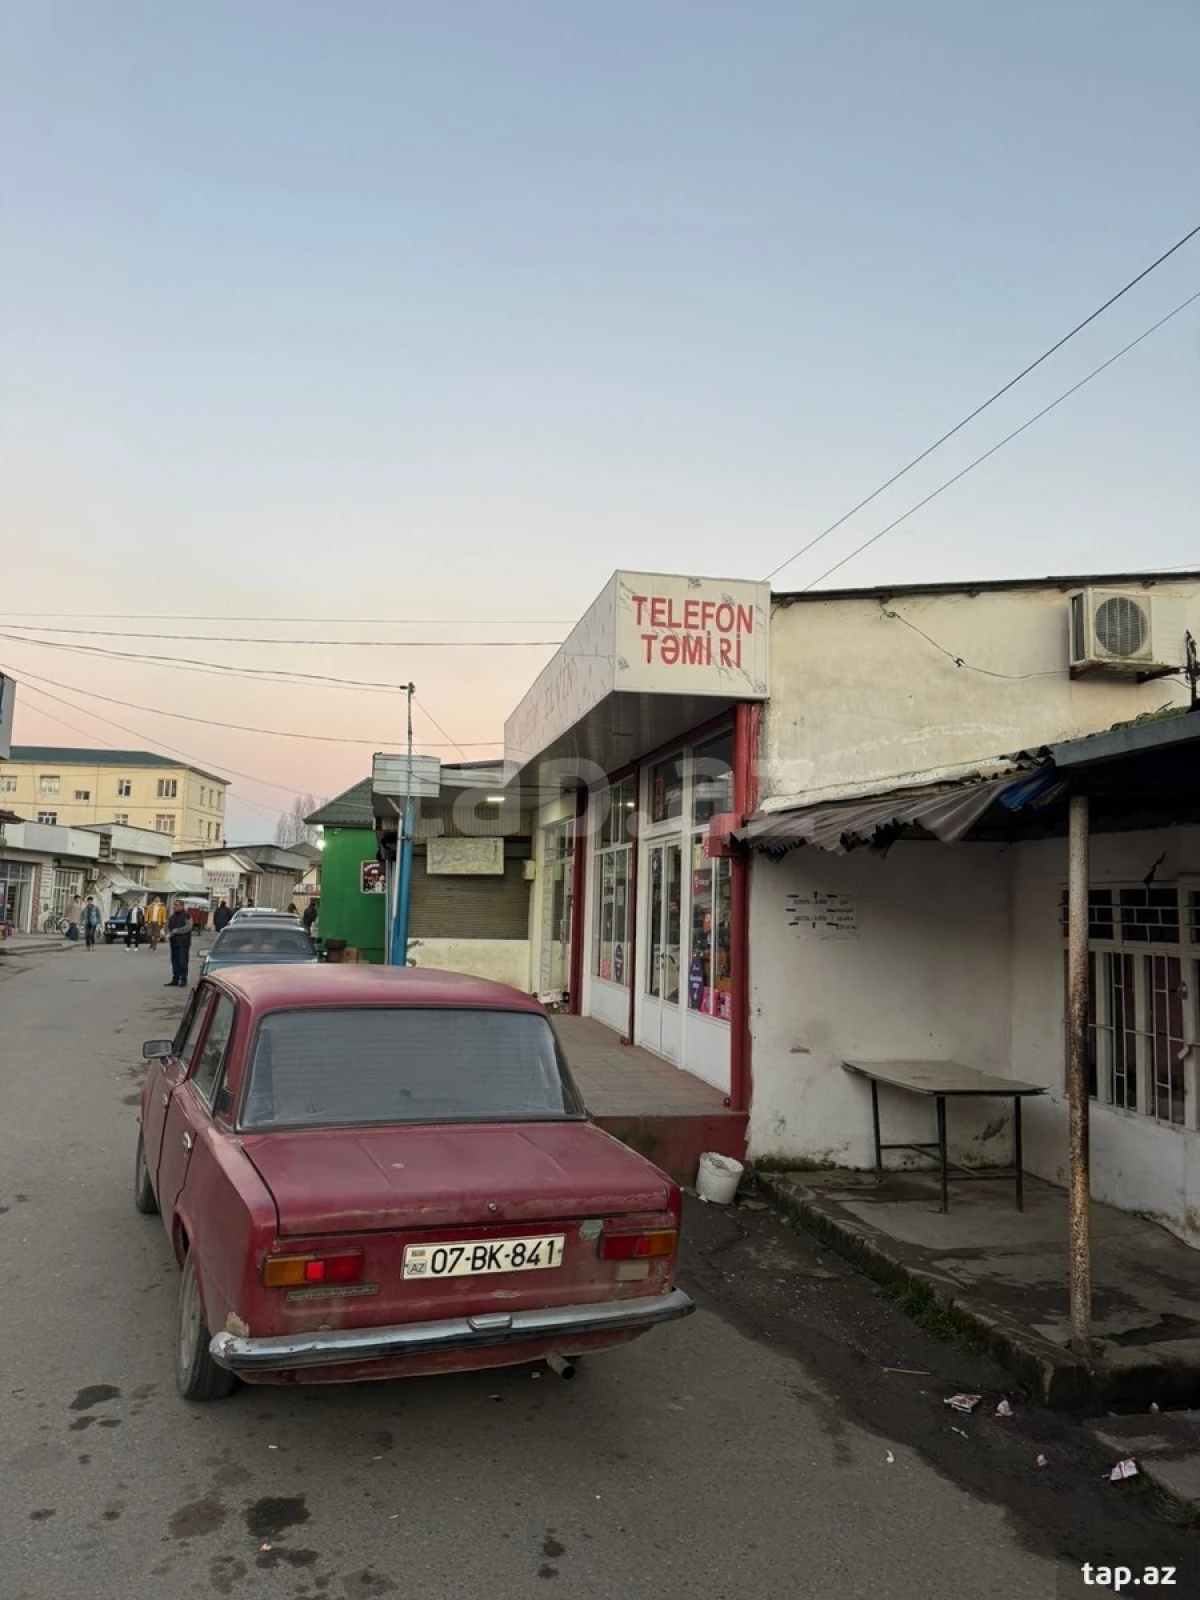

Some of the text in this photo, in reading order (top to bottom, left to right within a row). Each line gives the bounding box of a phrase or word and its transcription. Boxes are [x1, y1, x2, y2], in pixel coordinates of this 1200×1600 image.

[632, 595, 753, 634] TELEFON
[410, 1262, 425, 1273] AZ
[431, 1239, 556, 1274] 07-BK-841
